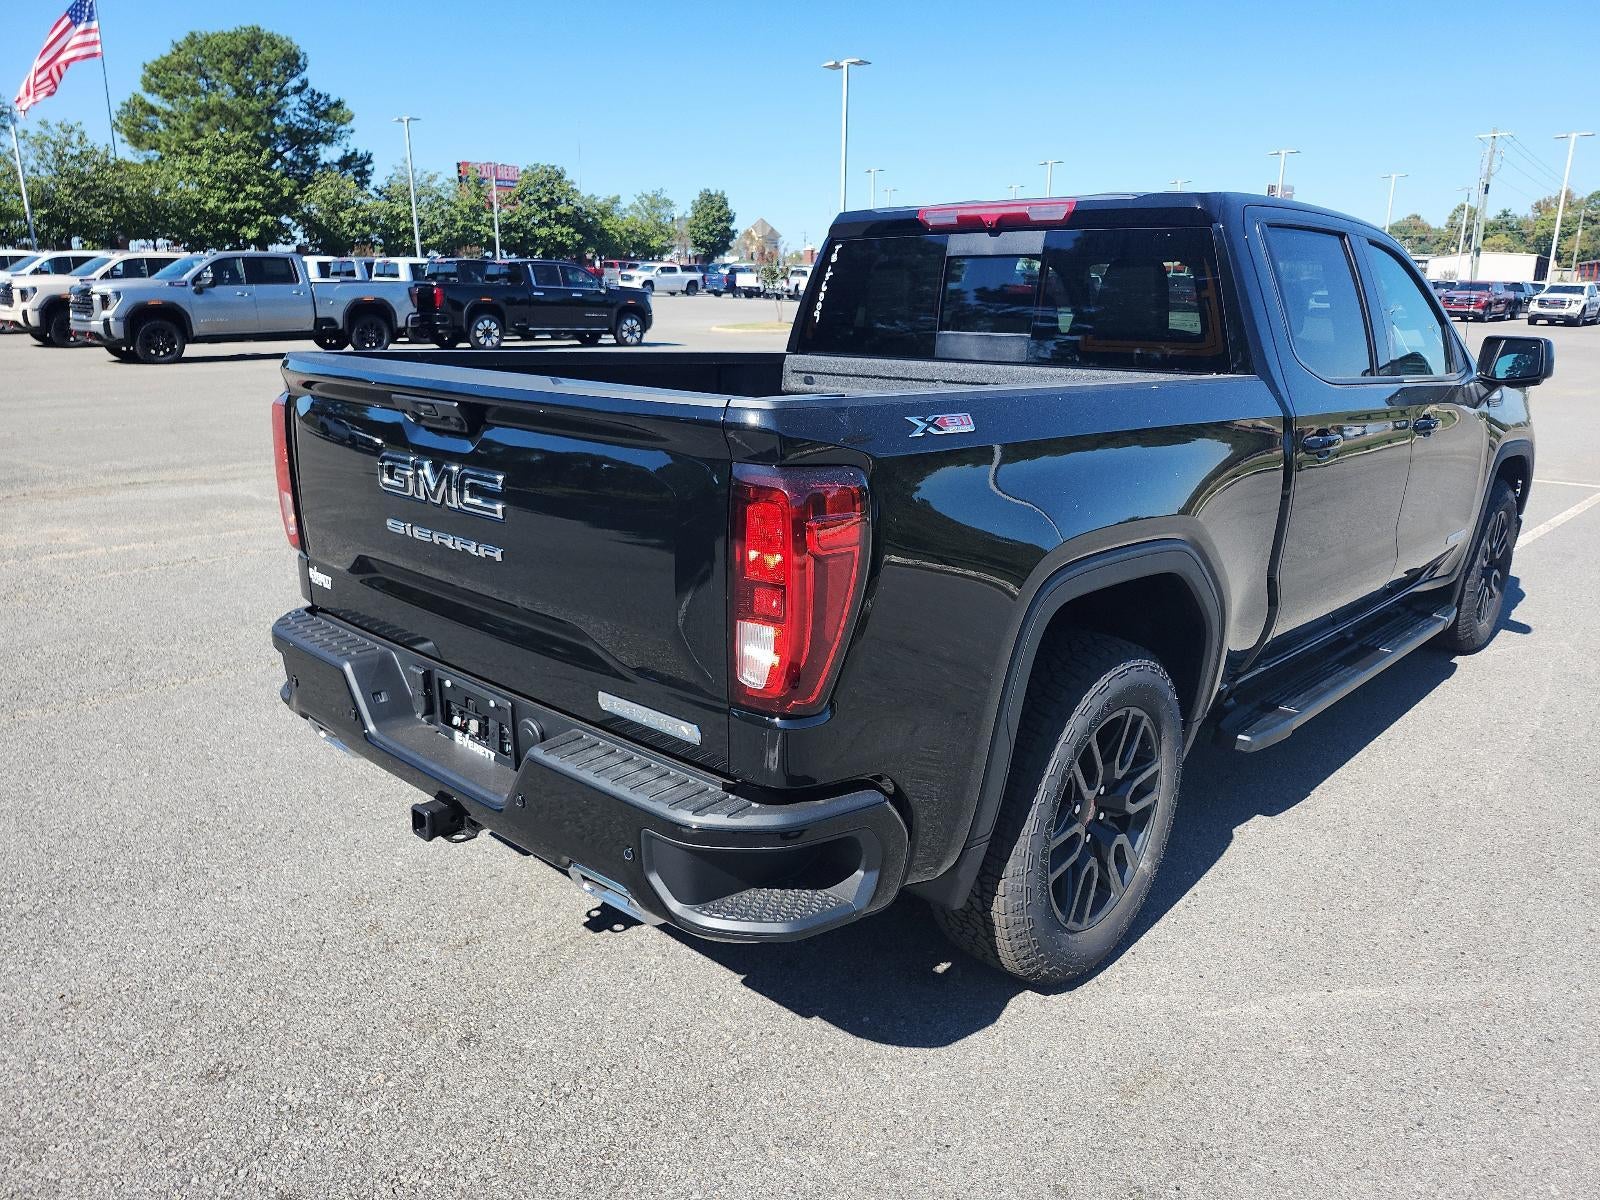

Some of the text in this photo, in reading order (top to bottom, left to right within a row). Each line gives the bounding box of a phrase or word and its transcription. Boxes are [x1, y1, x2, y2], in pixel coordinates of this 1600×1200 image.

[497, 165, 519, 180] HERE
[378, 450, 506, 522] GMC
[386, 518, 504, 562] SIERRA
